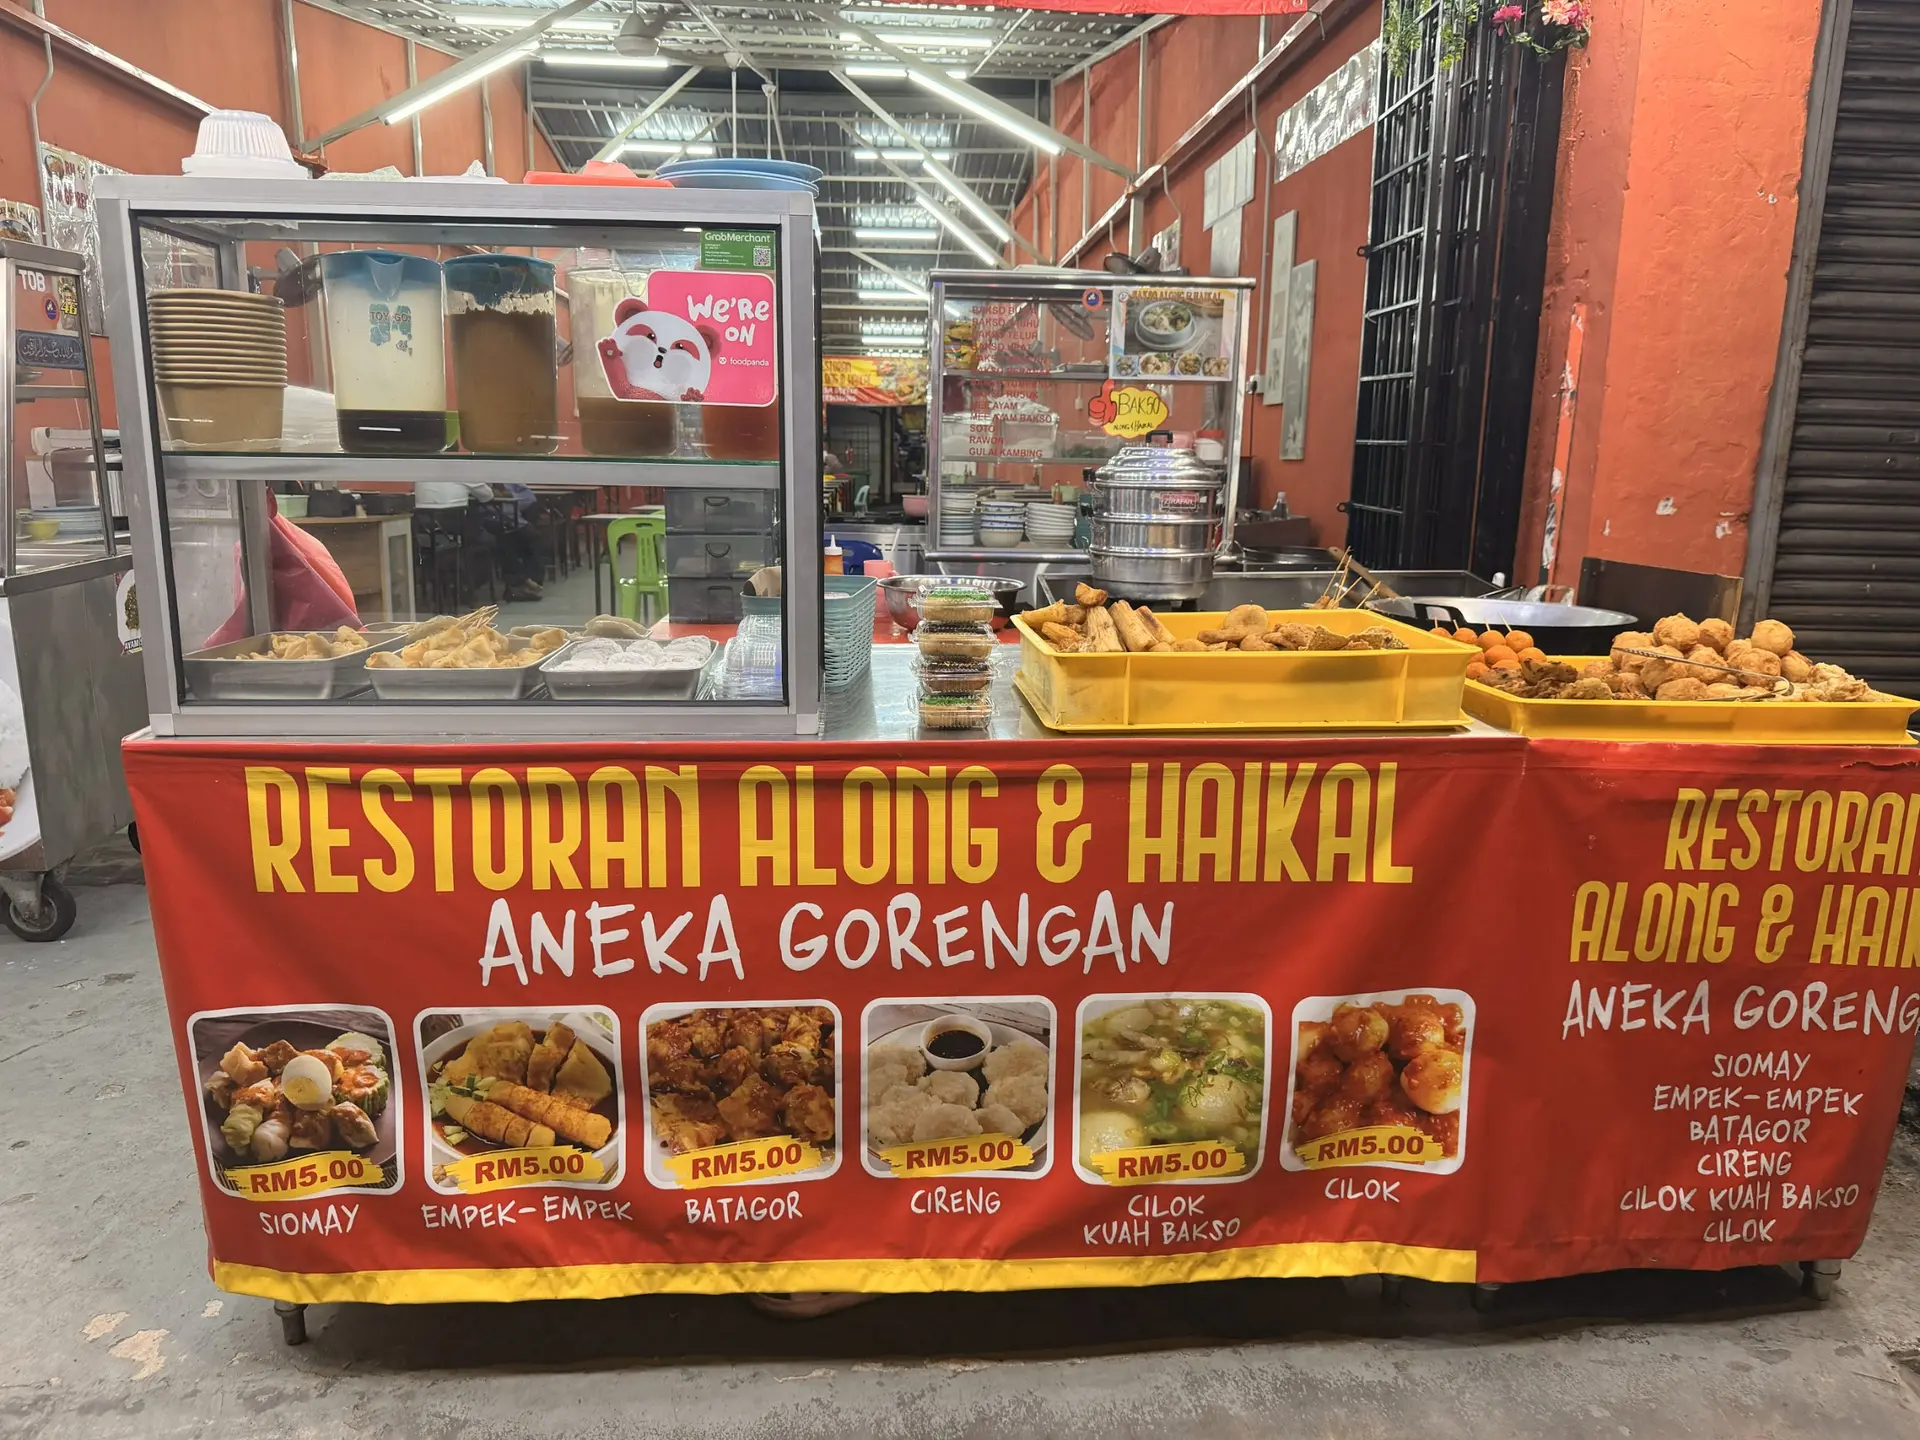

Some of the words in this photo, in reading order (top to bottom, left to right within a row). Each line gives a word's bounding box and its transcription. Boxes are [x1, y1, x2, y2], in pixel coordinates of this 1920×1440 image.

[704, 232, 771, 242] GrabMerchant
[60, 300, 78, 315] 46
[725, 323, 756, 346] ON
[1008, 331, 1038, 340] TELUR
[730, 357, 770, 367] foodpanda
[993, 401, 1018, 410] AYAM
[993, 413, 1017, 422] AYAM
[1020, 414, 1052, 423] BAKSO
[969, 425, 995, 433] SOTO
[969, 435, 1004, 445] RAWON
[969, 447, 998, 457] GULAI
[1000, 448, 1043, 458] KAMBING
[124, 639, 139, 651] AYAM
[244, 765, 701, 893] RESTORAN
[738, 764, 999, 887] ALONG
[1036, 763, 1092, 884] &
[1127, 762, 1414, 884] HAIKAL
[1569, 880, 1740, 964] ALONG
[1754, 883, 1795, 964] &
[478, 893, 745, 987] ANEKA
[778, 889, 1175, 976] GORENGAN
[1562, 979, 1711, 1040] ANEKA
[1733, 980, 1920, 1036] GORENG
[1711, 1050, 1811, 1082] SIOMAY
[1653, 1084, 1864, 1116] EMPEK-EMPEK
[1690, 1114, 1811, 1146] BATAGOR
[691, 1143, 803, 1180] RM5.00
[906, 1140, 1014, 1170] RM5.00
[1117, 1147, 1228, 1179] RM5.00
[1317, 1134, 1424, 1162] RM5.00
[1697, 1148, 1792, 1178] CIRENG
[250, 1158, 364, 1194] RM5.00
[474, 1153, 585, 1185] RM5.00
[909, 1185, 1002, 1215] CIRENG
[1324, 1177, 1401, 1203] CILOK
[1619, 1185, 1698, 1212] CILOK
[1709, 1180, 1772, 1212] KUAH
[1781, 1182, 1860, 1210] BAKSO
[259, 1203, 360, 1236] SIOMAY
[420, 1195, 634, 1230] EMPEK-EMPEK
[684, 1190, 803, 1225] BATAGOR
[1127, 1193, 1205, 1218] CILOK
[1083, 1218, 1150, 1247] KUAH
[1162, 1216, 1241, 1245] BAKSO
[1702, 1217, 1777, 1243] CILOK
